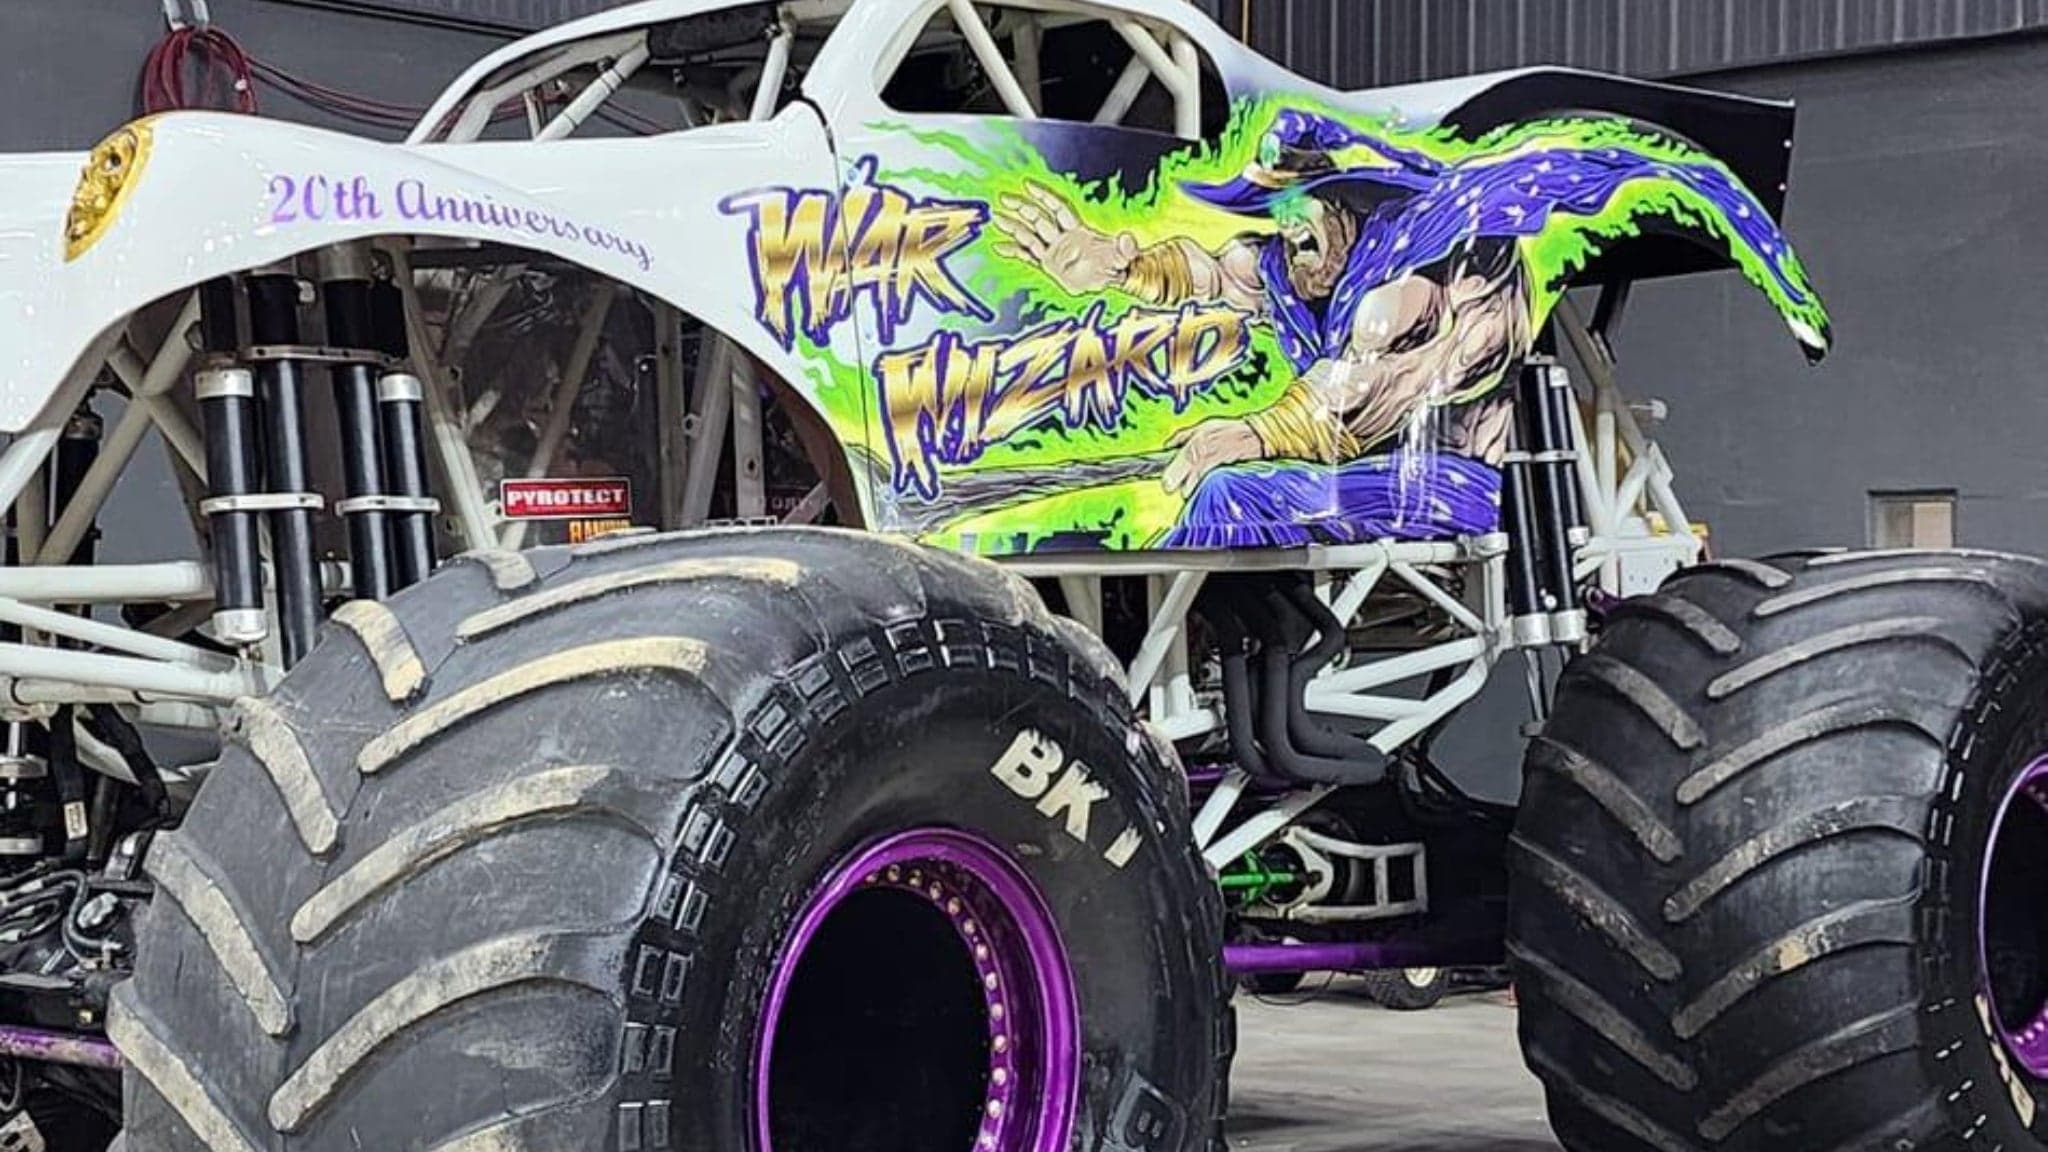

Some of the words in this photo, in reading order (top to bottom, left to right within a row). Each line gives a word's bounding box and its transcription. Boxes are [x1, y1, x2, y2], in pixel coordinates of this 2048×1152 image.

[269, 174, 381, 223] 20th
[396, 179, 652, 270] Anniversary
[719, 155, 995, 351] WAR
[872, 301, 1257, 501] WIZARD
[507, 489, 625, 506] PYROTECT
